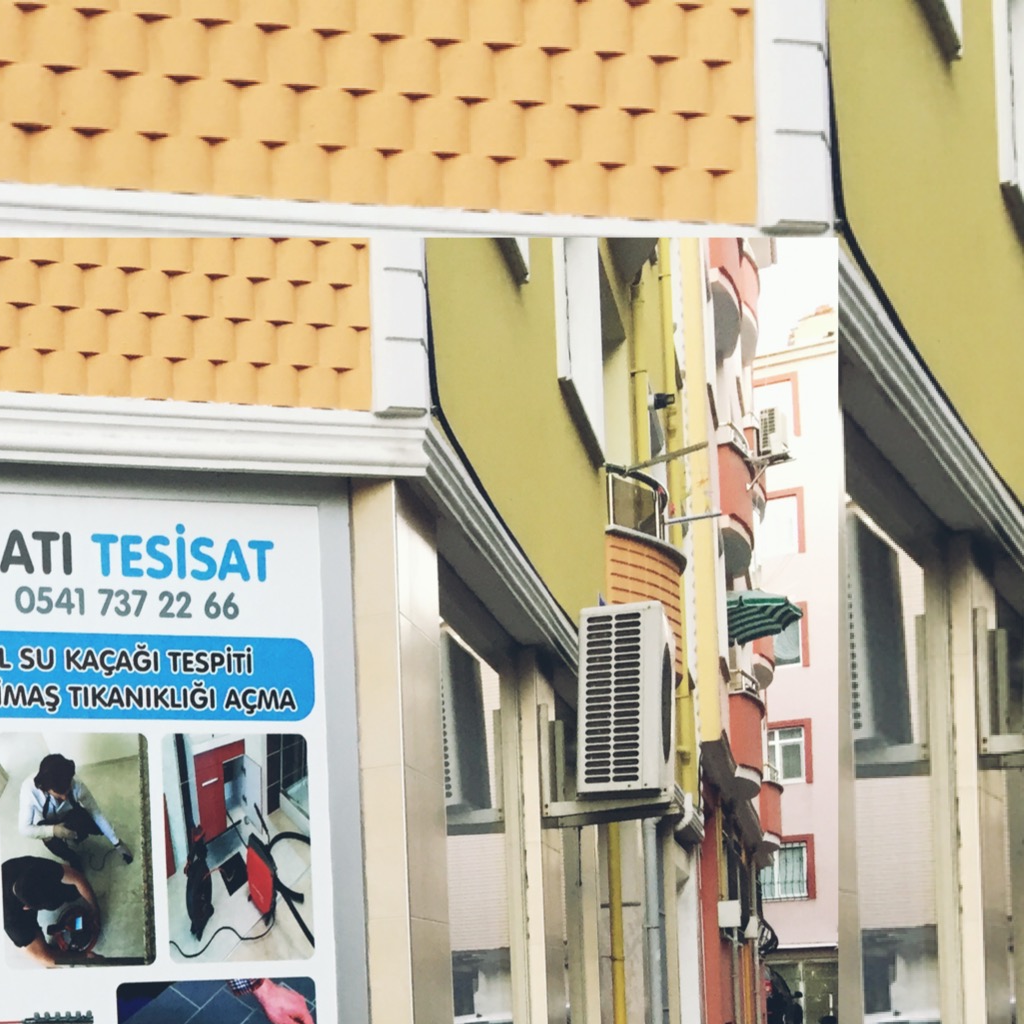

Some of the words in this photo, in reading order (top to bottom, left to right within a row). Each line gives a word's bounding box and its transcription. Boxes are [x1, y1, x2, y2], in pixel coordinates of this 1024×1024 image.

[91, 523, 274, 582] TESİSAT
[15, 585, 86, 616] 0541
[98, 588, 148, 617] 737
[158, 590, 193, 619] 22
[204, 591, 240, 620] 66
[19, 646, 56, 671] SU
[64, 642, 159, 678] KAÇAĞI
[166, 645, 254, 675] TESPİTİ
[68, 680, 217, 711] TIKANIKLIĞI
[224, 686, 298, 716] AÇMA
